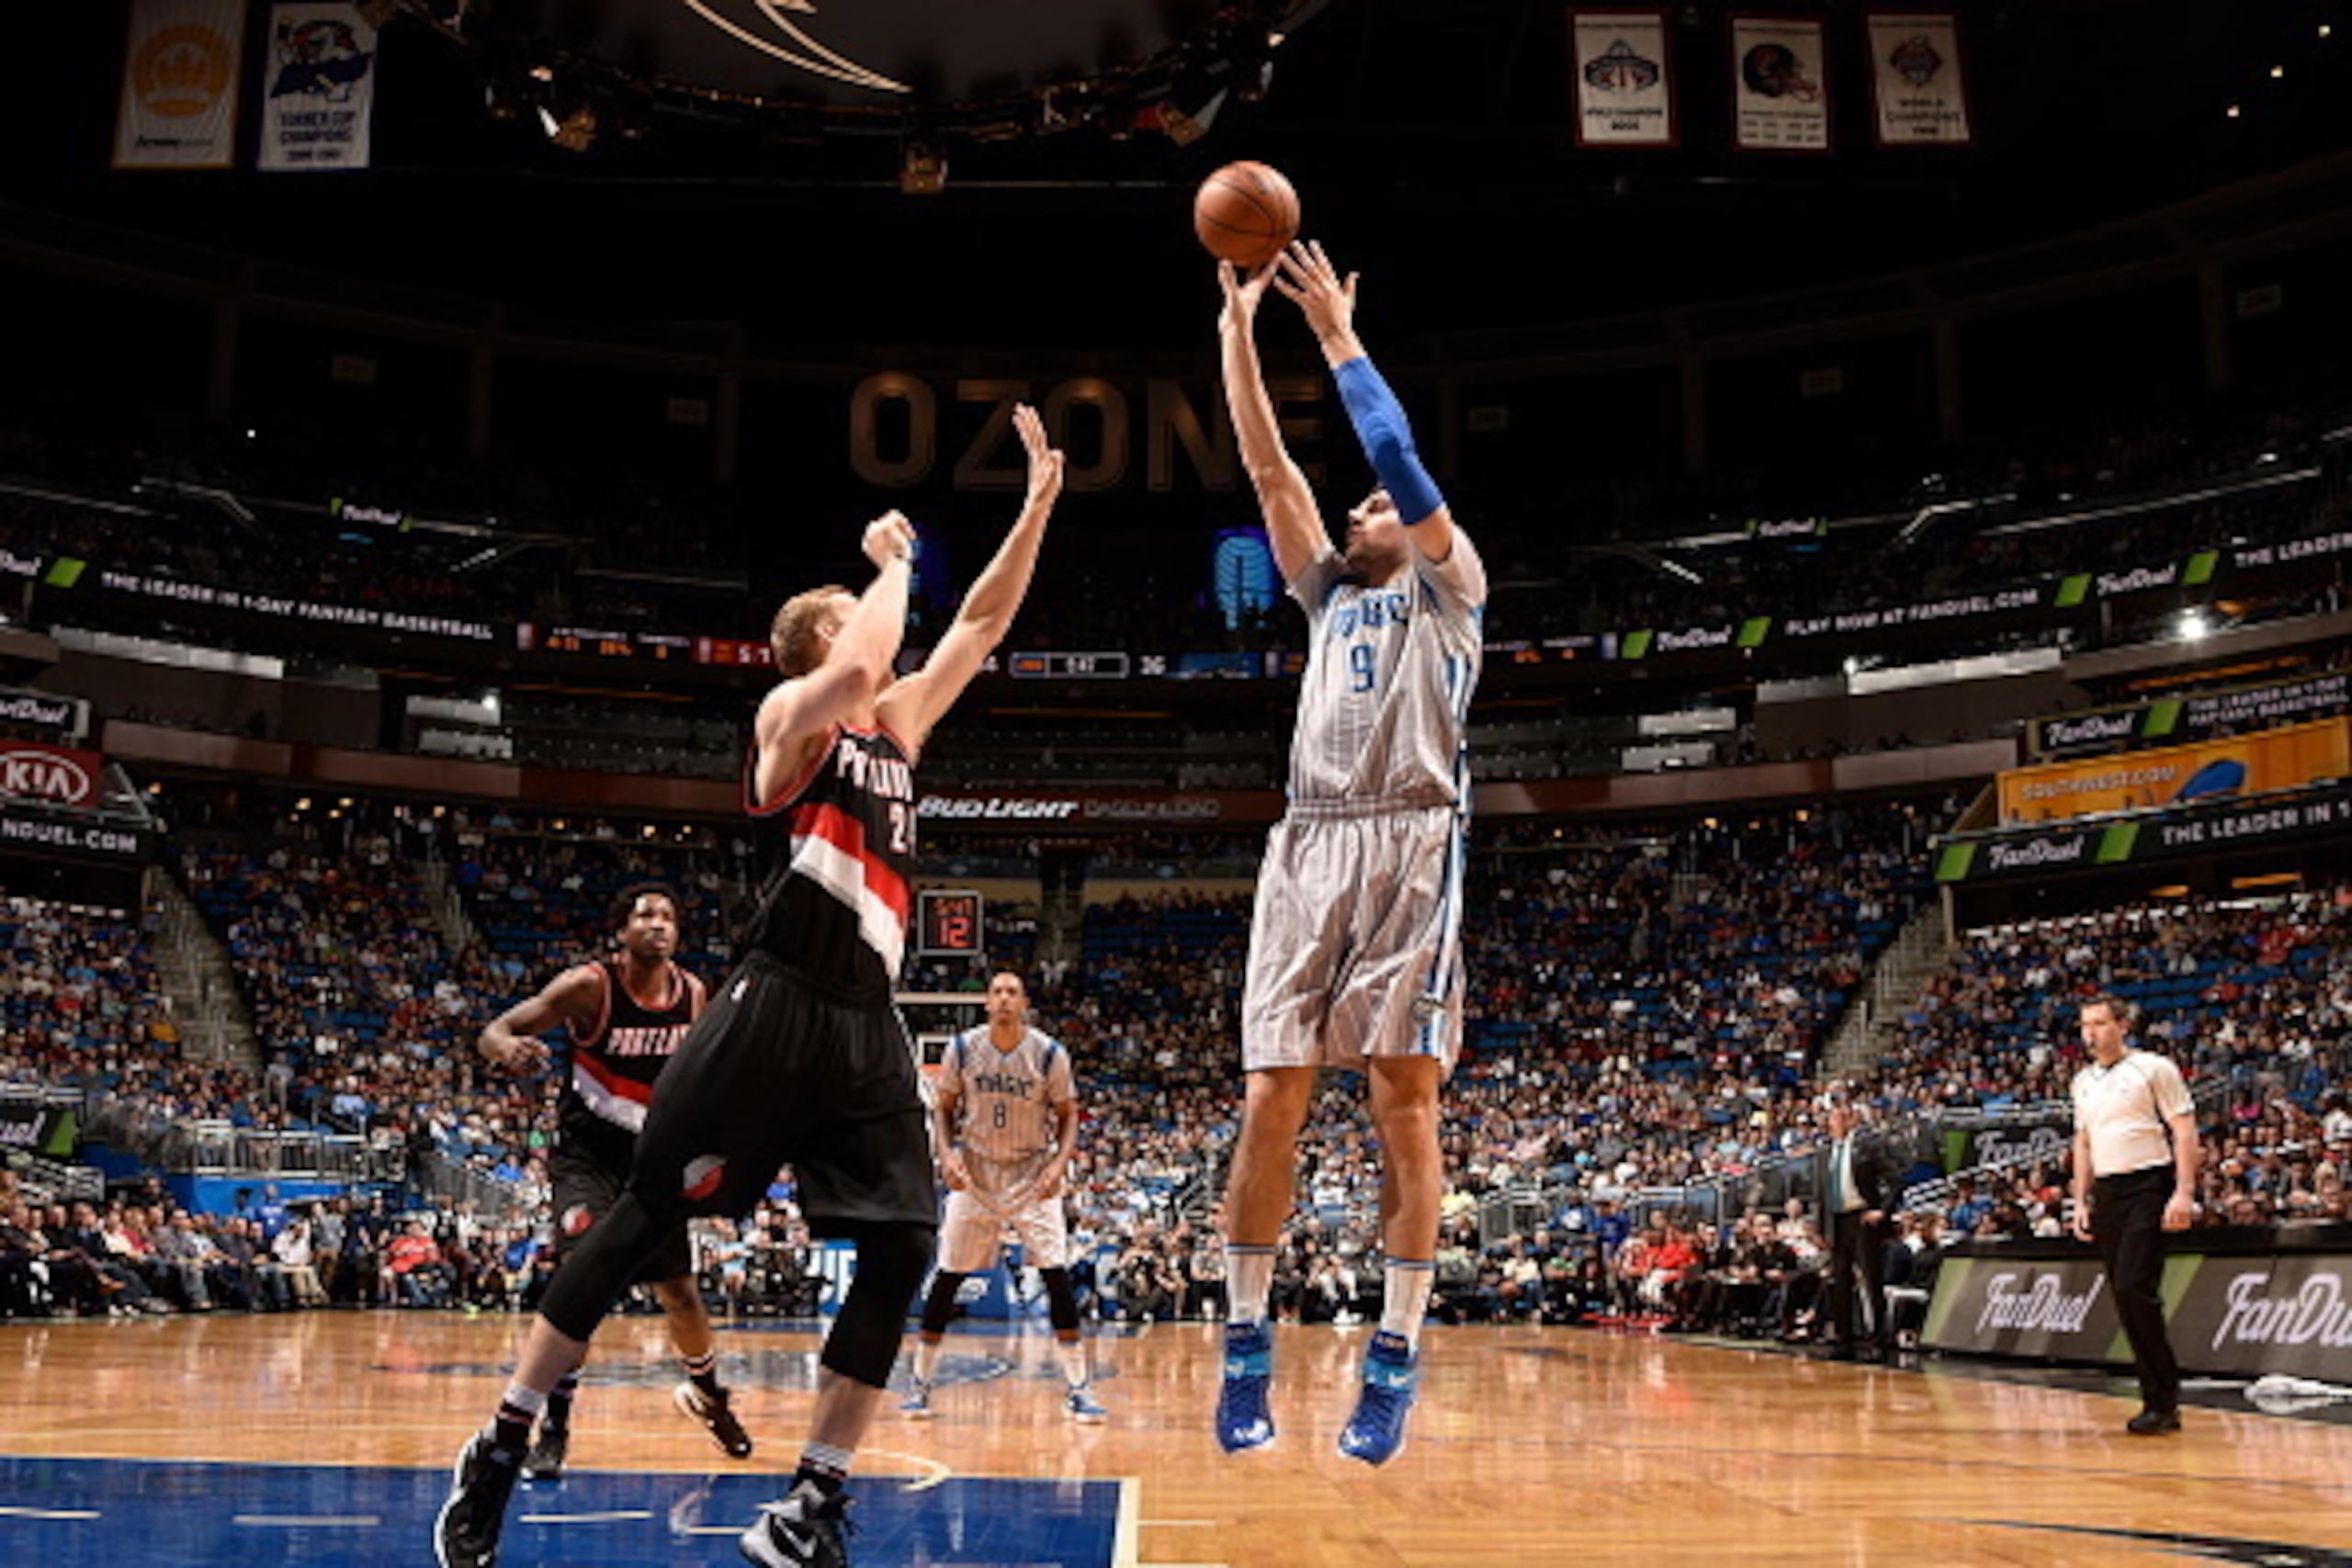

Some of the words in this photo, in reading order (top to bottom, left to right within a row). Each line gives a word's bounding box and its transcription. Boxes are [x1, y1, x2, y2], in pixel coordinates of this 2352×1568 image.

[101, 570, 141, 592] THE
[142, 576, 216, 604] LEADER
[298, 600, 379, 625] FANTASY
[381, 610, 494, 640] BASKETBALL
[1351, 644, 1374, 693] 9
[5, 759, 72, 801] KIA
[918, 795, 983, 819] BUD
[983, 797, 1079, 819] LIGHT
[1987, 833, 2086, 871] FanDuel
[2162, 822, 2205, 847] THE
[2211, 806, 2300, 840] LEADER
[2303, 802, 2330, 825] IN
[993, 1102, 1006, 1129] 8
[1974, 1273, 2105, 1335] FanDuel
